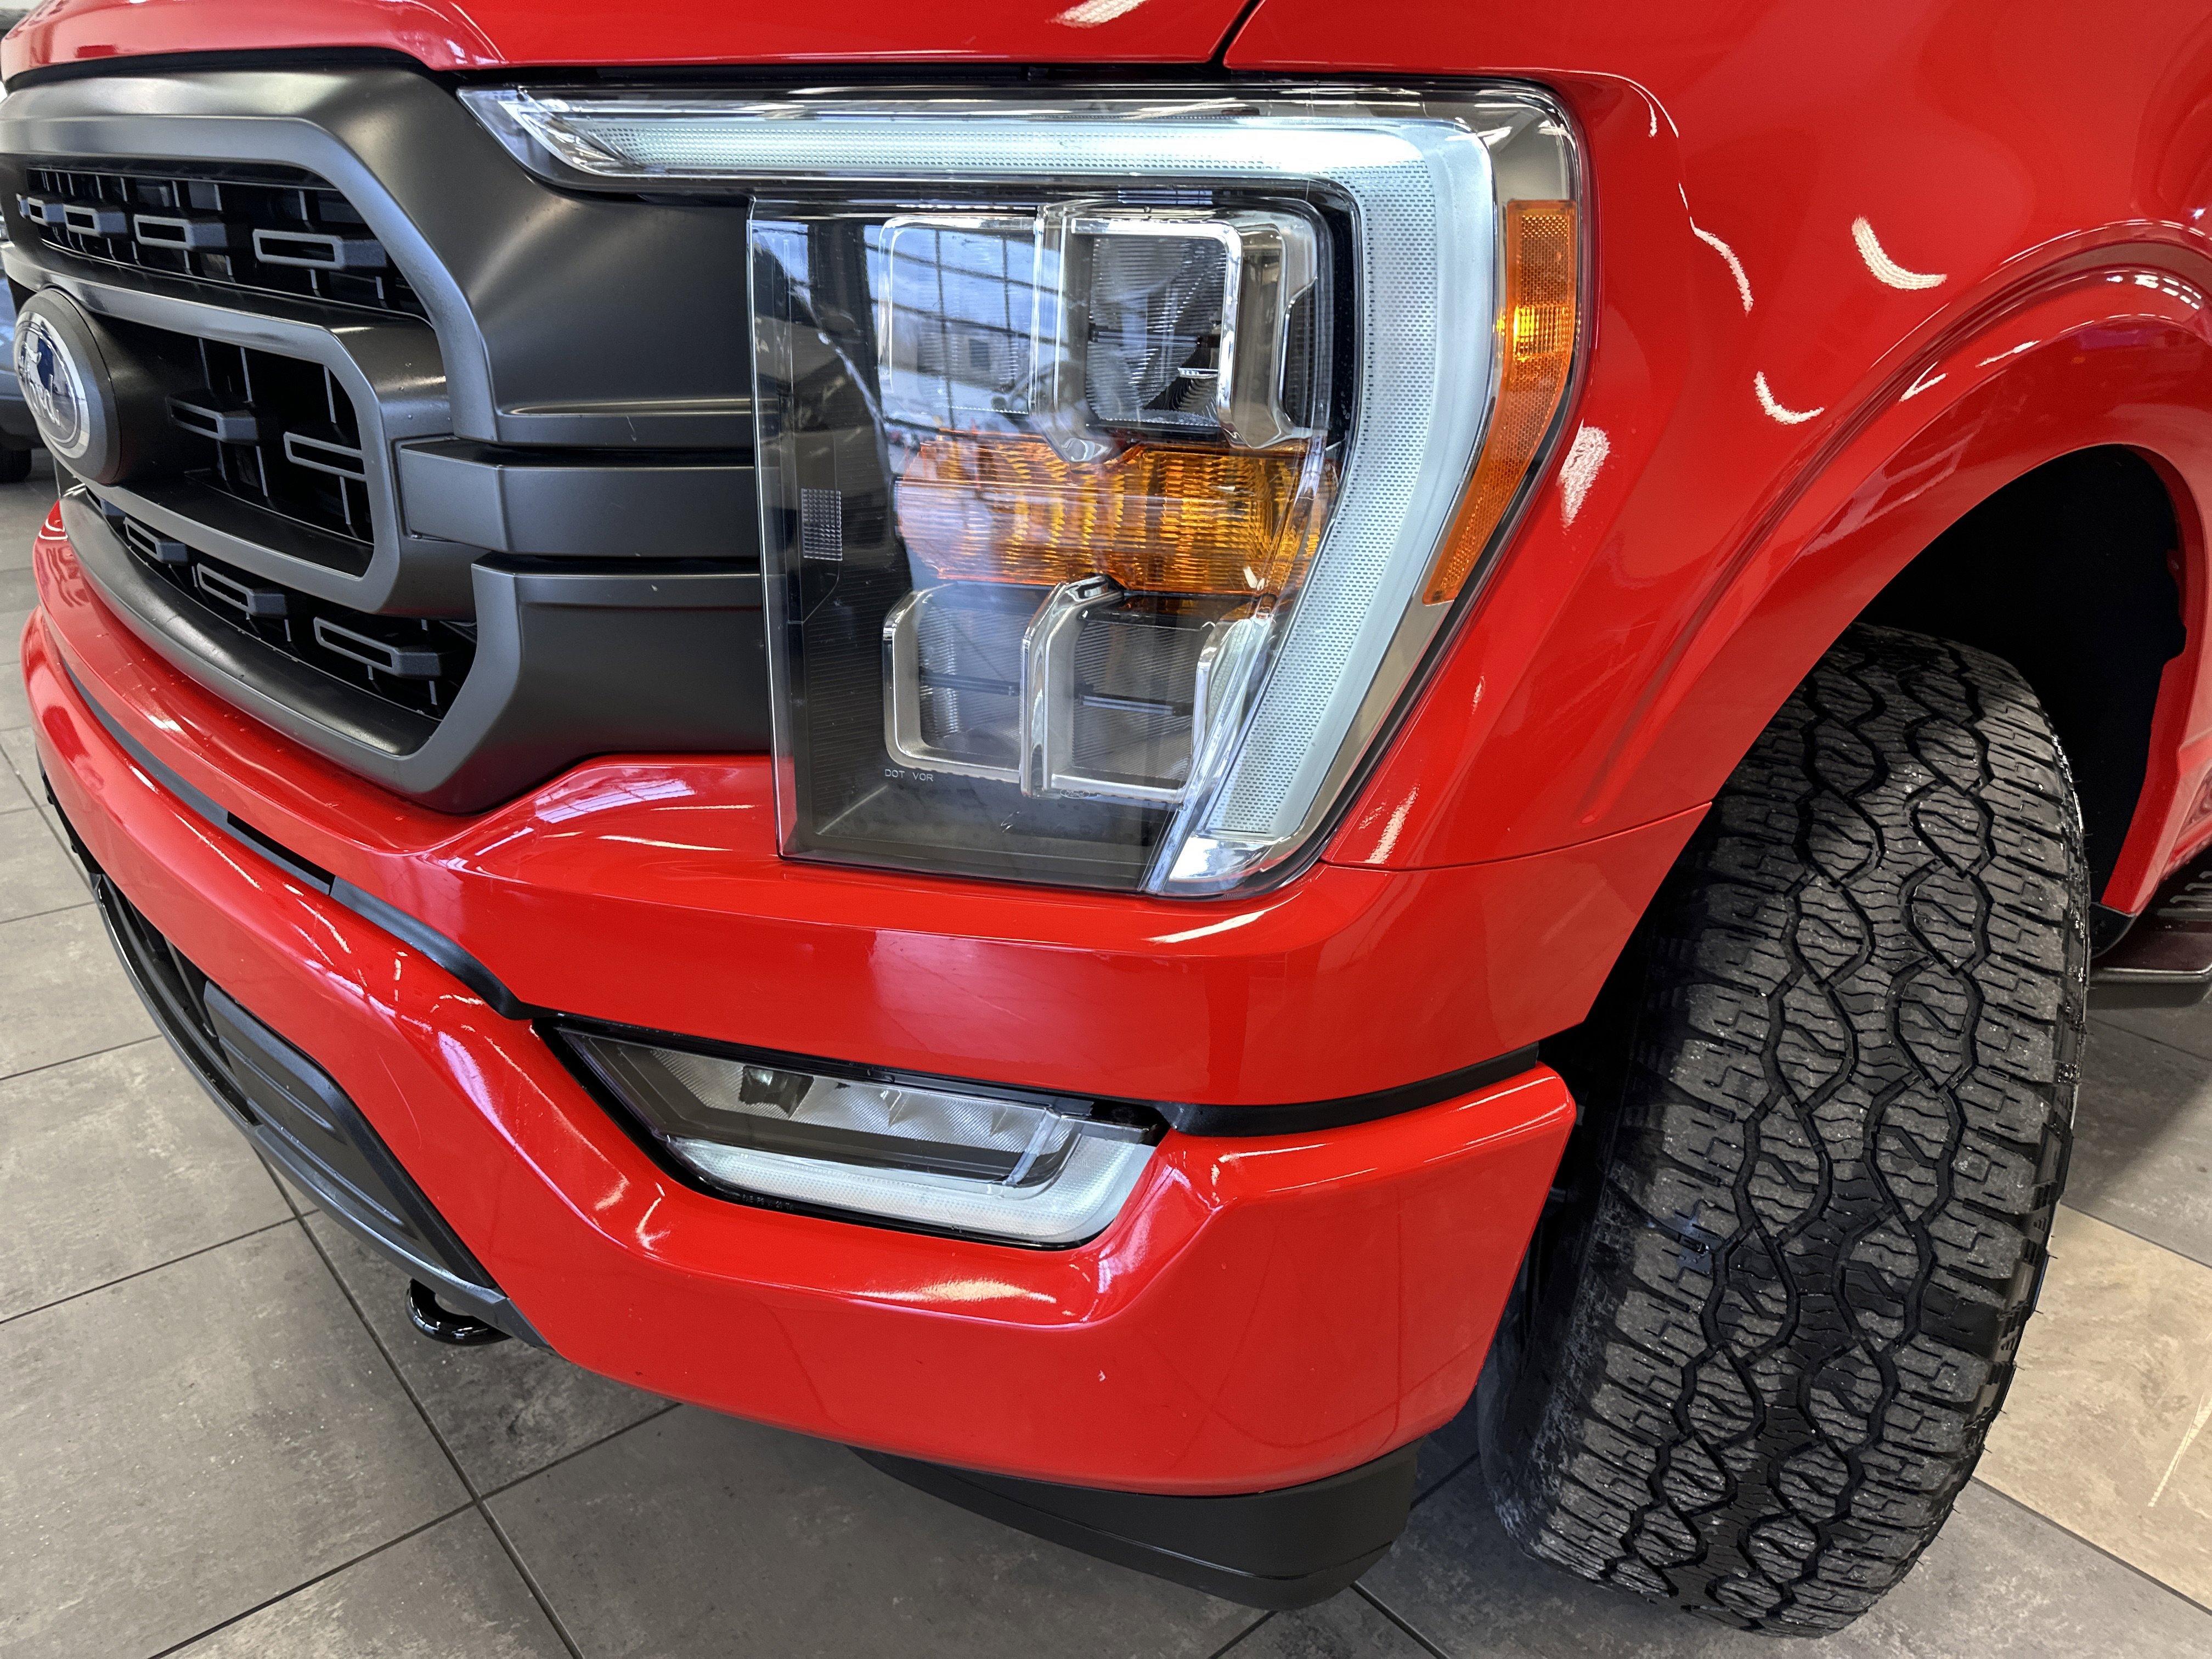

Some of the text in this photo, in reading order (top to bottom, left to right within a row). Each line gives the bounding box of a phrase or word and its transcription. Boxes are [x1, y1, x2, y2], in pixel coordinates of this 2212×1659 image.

[19, 341, 61, 427] Ford
[884, 769, 934, 782] DOT VOR
